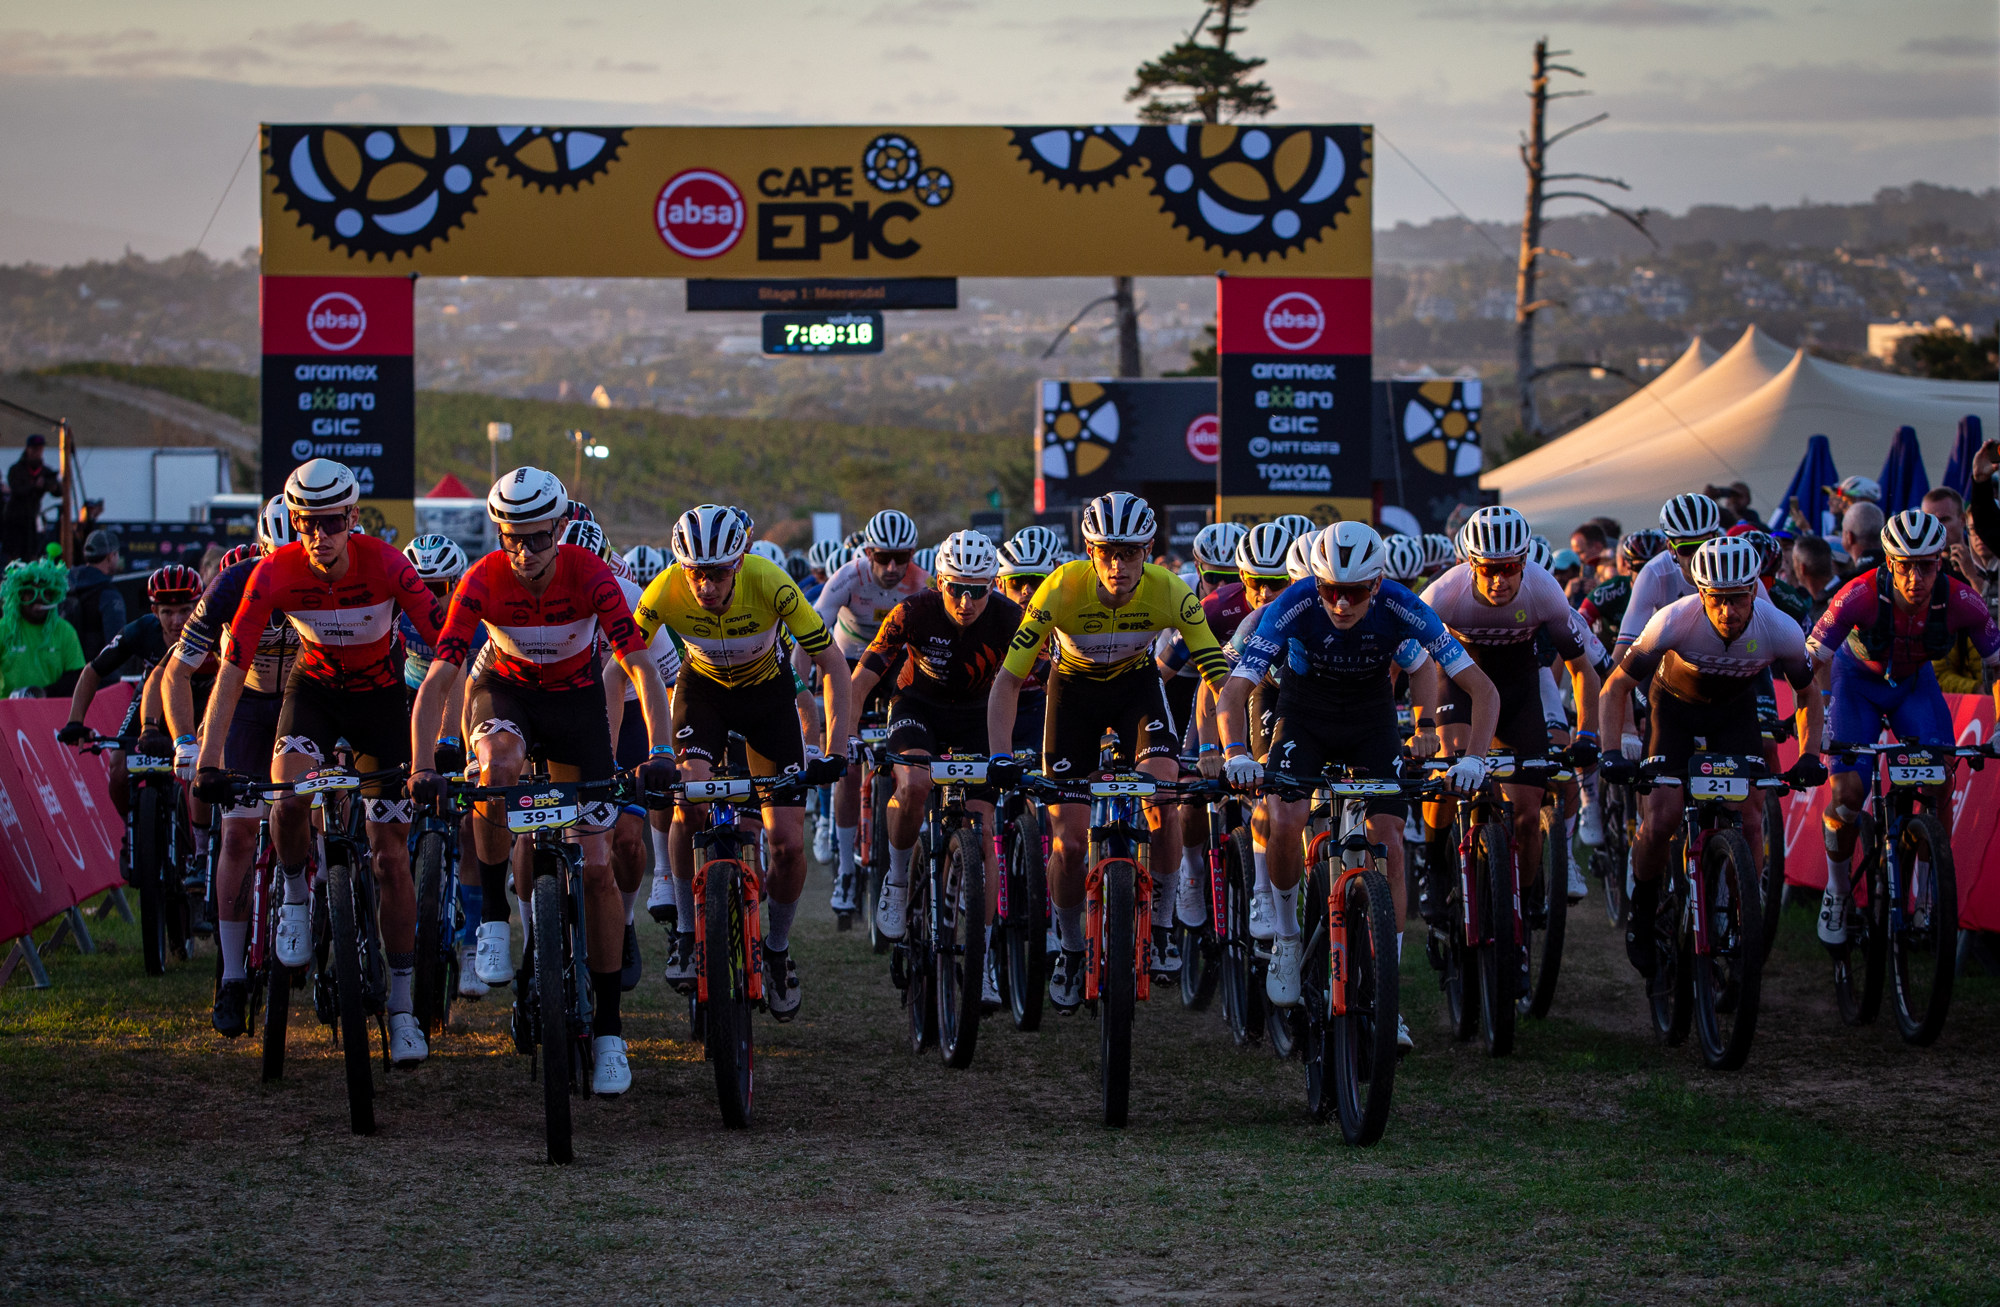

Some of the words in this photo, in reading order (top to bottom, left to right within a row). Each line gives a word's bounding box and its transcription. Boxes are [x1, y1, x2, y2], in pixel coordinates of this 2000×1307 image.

[758, 168, 852, 197] CAPE
[668, 197, 735, 226] absa
[757, 202, 922, 261] EPIC
[314, 309, 359, 330] absa
[1271, 309, 1318, 330] absa
[784, 324, 874, 346] 7:00:10
[294, 365, 378, 382] aramex
[1251, 363, 1336, 381] aramex
[298, 387, 376, 411] exxaro
[1255, 385, 1334, 410] exxaro
[1256, 464, 1332, 481] TOYOTA
[597, 590, 619, 606] absa
[778, 592, 796, 613] absa
[1593, 581, 1626, 607] Ford
[1275, 597, 1313, 631] SHIMANO
[1385, 597, 1427, 631] SHIMANO
[314, 619, 368, 628] Honeycomb
[517, 640, 571, 648] Honeycomb
[1248, 641, 1280, 656] TECH
[1429, 636, 1453, 655] TECH
[1246, 655, 1269, 668] VYE
[1440, 646, 1459, 664] VYE
[1683, 651, 1771, 667] SCOTT
[686, 745, 715, 761] vittoria
[1137, 744, 1170, 759] vittoria
[947, 763, 975, 776] 6-2
[1909, 757, 1930, 766] EPIC
[1713, 767, 1735, 776] EPIC
[1900, 769, 1935, 778] 37-2
[307, 777, 348, 789] 39-2
[704, 782, 731, 795] 9-1
[1108, 783, 1139, 792] 9-2
[1708, 780, 1732, 792] 2-1
[533, 797, 560, 807] EPIC
[523, 809, 562, 825] 39-1
[998, 854, 1008, 911] MANITOU
[1213, 868, 1226, 928] MANITOU
